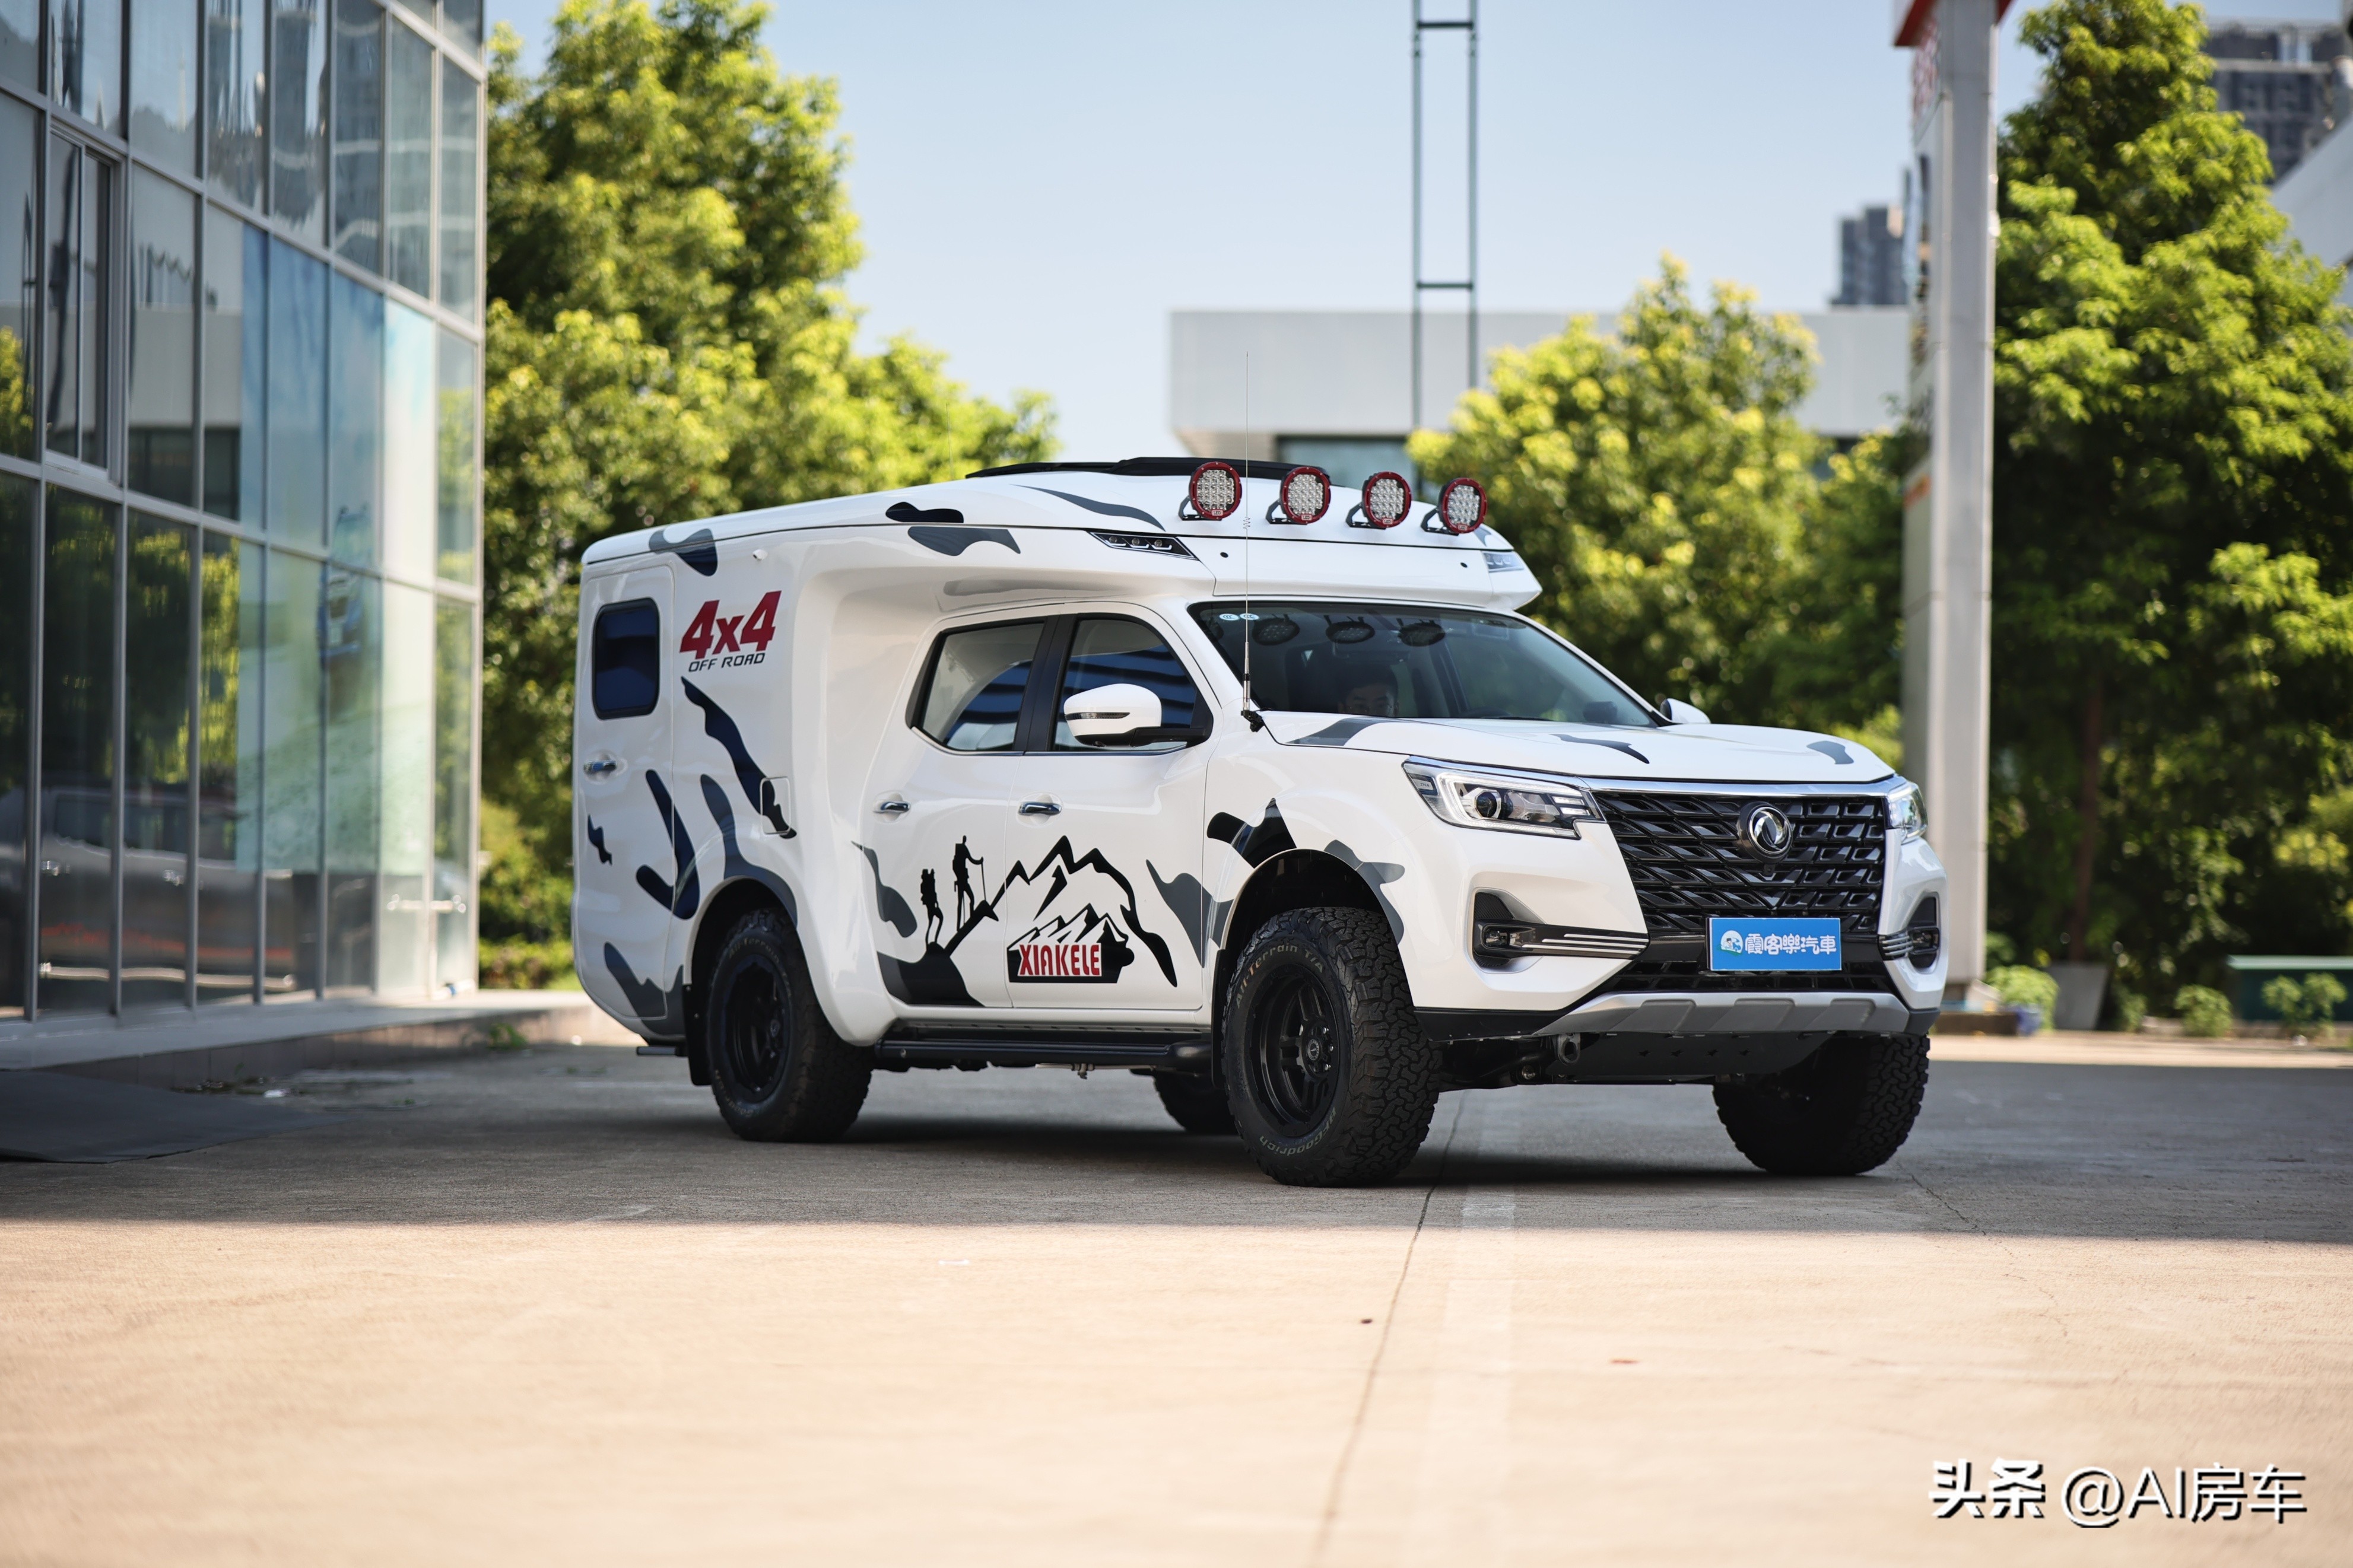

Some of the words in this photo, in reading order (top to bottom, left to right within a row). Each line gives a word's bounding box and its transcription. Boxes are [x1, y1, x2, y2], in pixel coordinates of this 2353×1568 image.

[679, 590, 782, 660] 4x4
[688, 658, 718, 672] OFF
[721, 653, 766, 668] ROAD
[1019, 944, 1100, 975] XIAKELE
[1236, 942, 1298, 1009] All-Terrain
[1304, 949, 1324, 974] T/A
[1259, 1106, 1336, 1156] BFGoodrich
